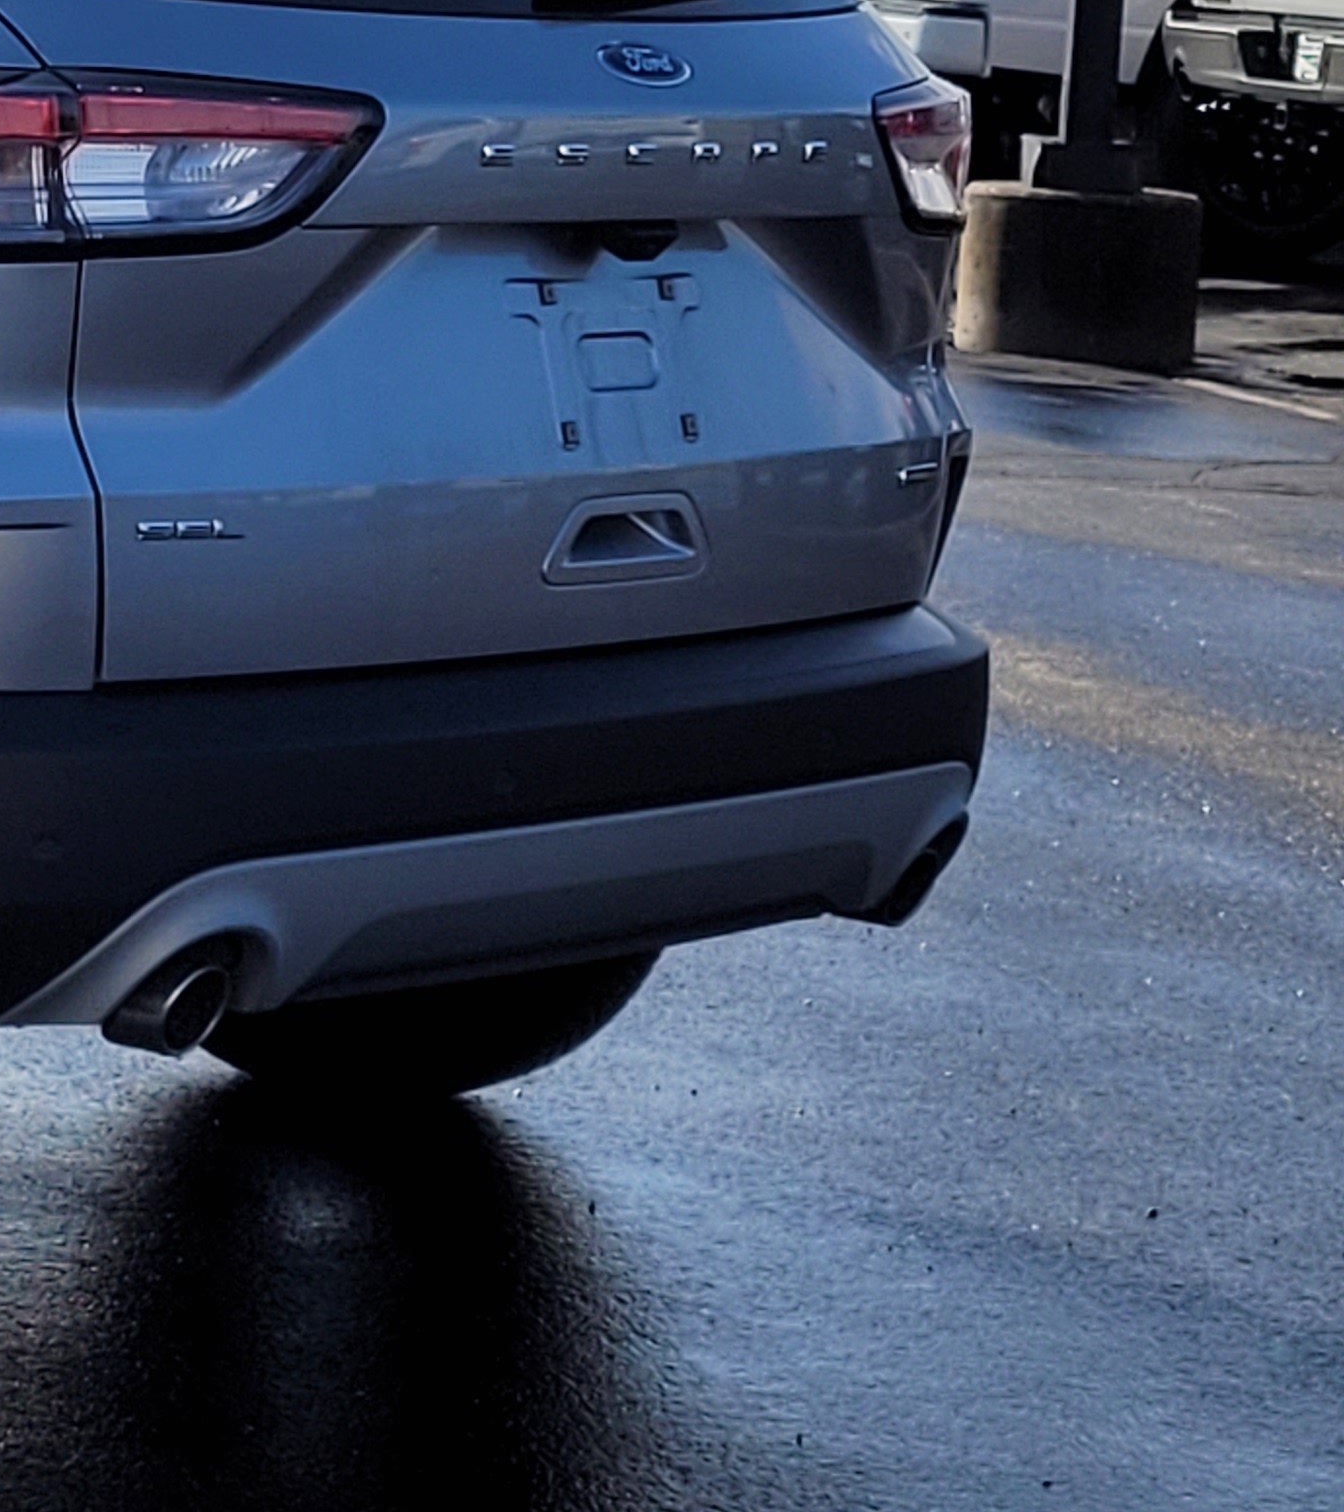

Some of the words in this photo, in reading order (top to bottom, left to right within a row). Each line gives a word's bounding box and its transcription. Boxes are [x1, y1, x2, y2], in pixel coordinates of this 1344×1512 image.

[621, 47, 675, 73] Ford
[480, 140, 829, 167] ESCAPE
[136, 518, 246, 540] SEL
